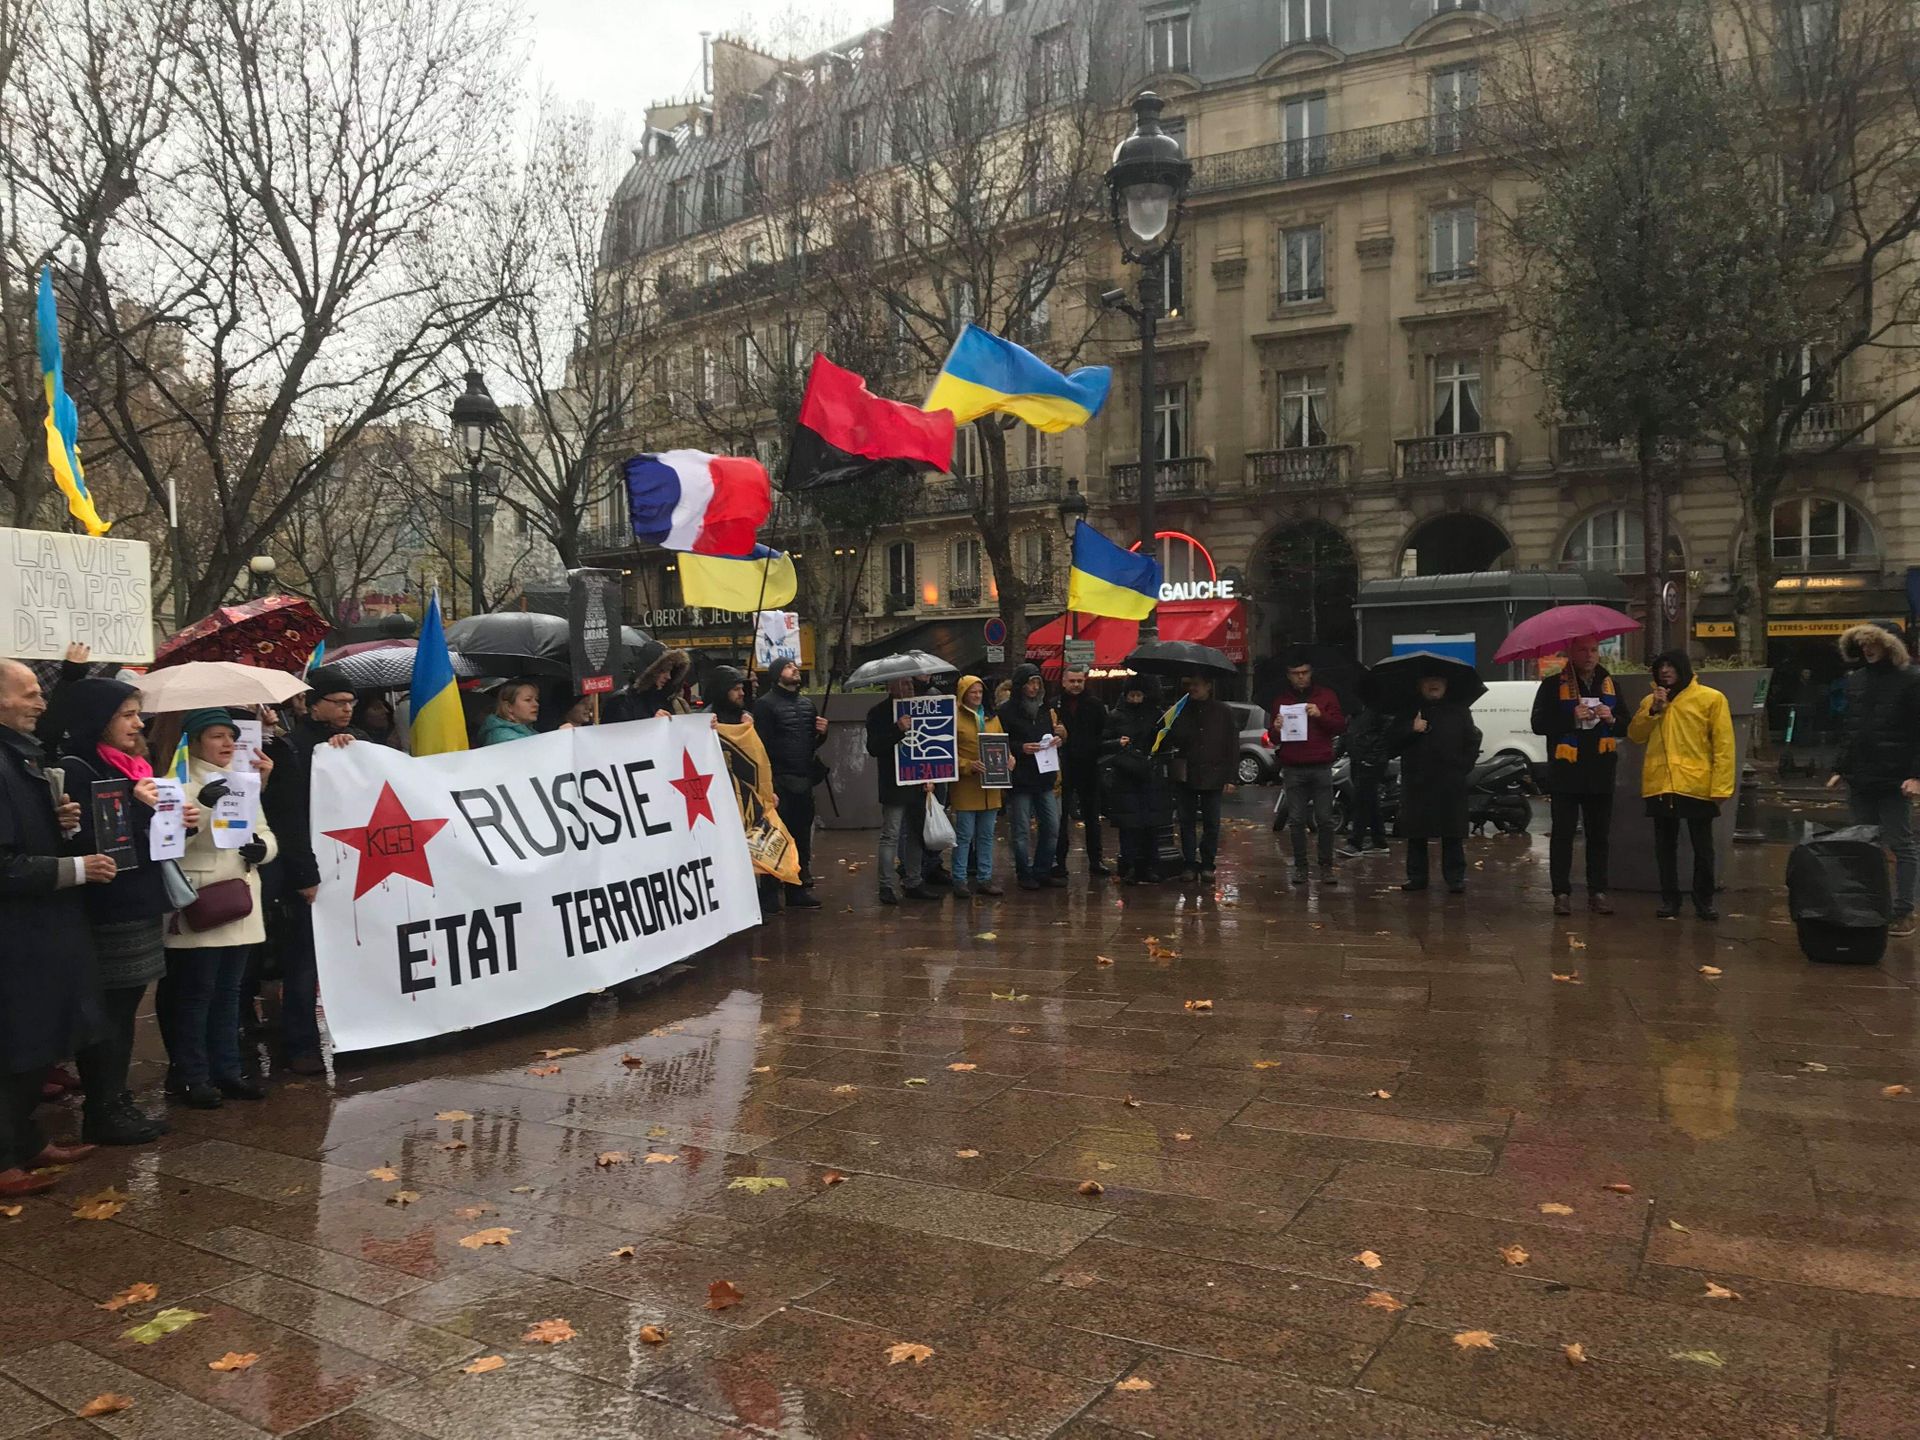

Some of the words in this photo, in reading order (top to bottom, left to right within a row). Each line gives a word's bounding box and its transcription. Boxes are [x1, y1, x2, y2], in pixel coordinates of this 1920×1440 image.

[11, 529, 61, 570] LA
[20, 569, 76, 609] N'A
[84, 573, 147, 615] PAS
[1158, 580, 1234, 602] GAUCHE
[14, 609, 60, 653] DE
[583, 628, 609, 640] UKRAINE
[643, 608, 684, 628] GIBERT
[909, 699, 942, 715] PEACE
[450, 759, 672, 866] RUSSIE
[365, 824, 415, 857] KGB
[397, 902, 523, 994] ETAT
[552, 856, 720, 958] TERRORISTE
